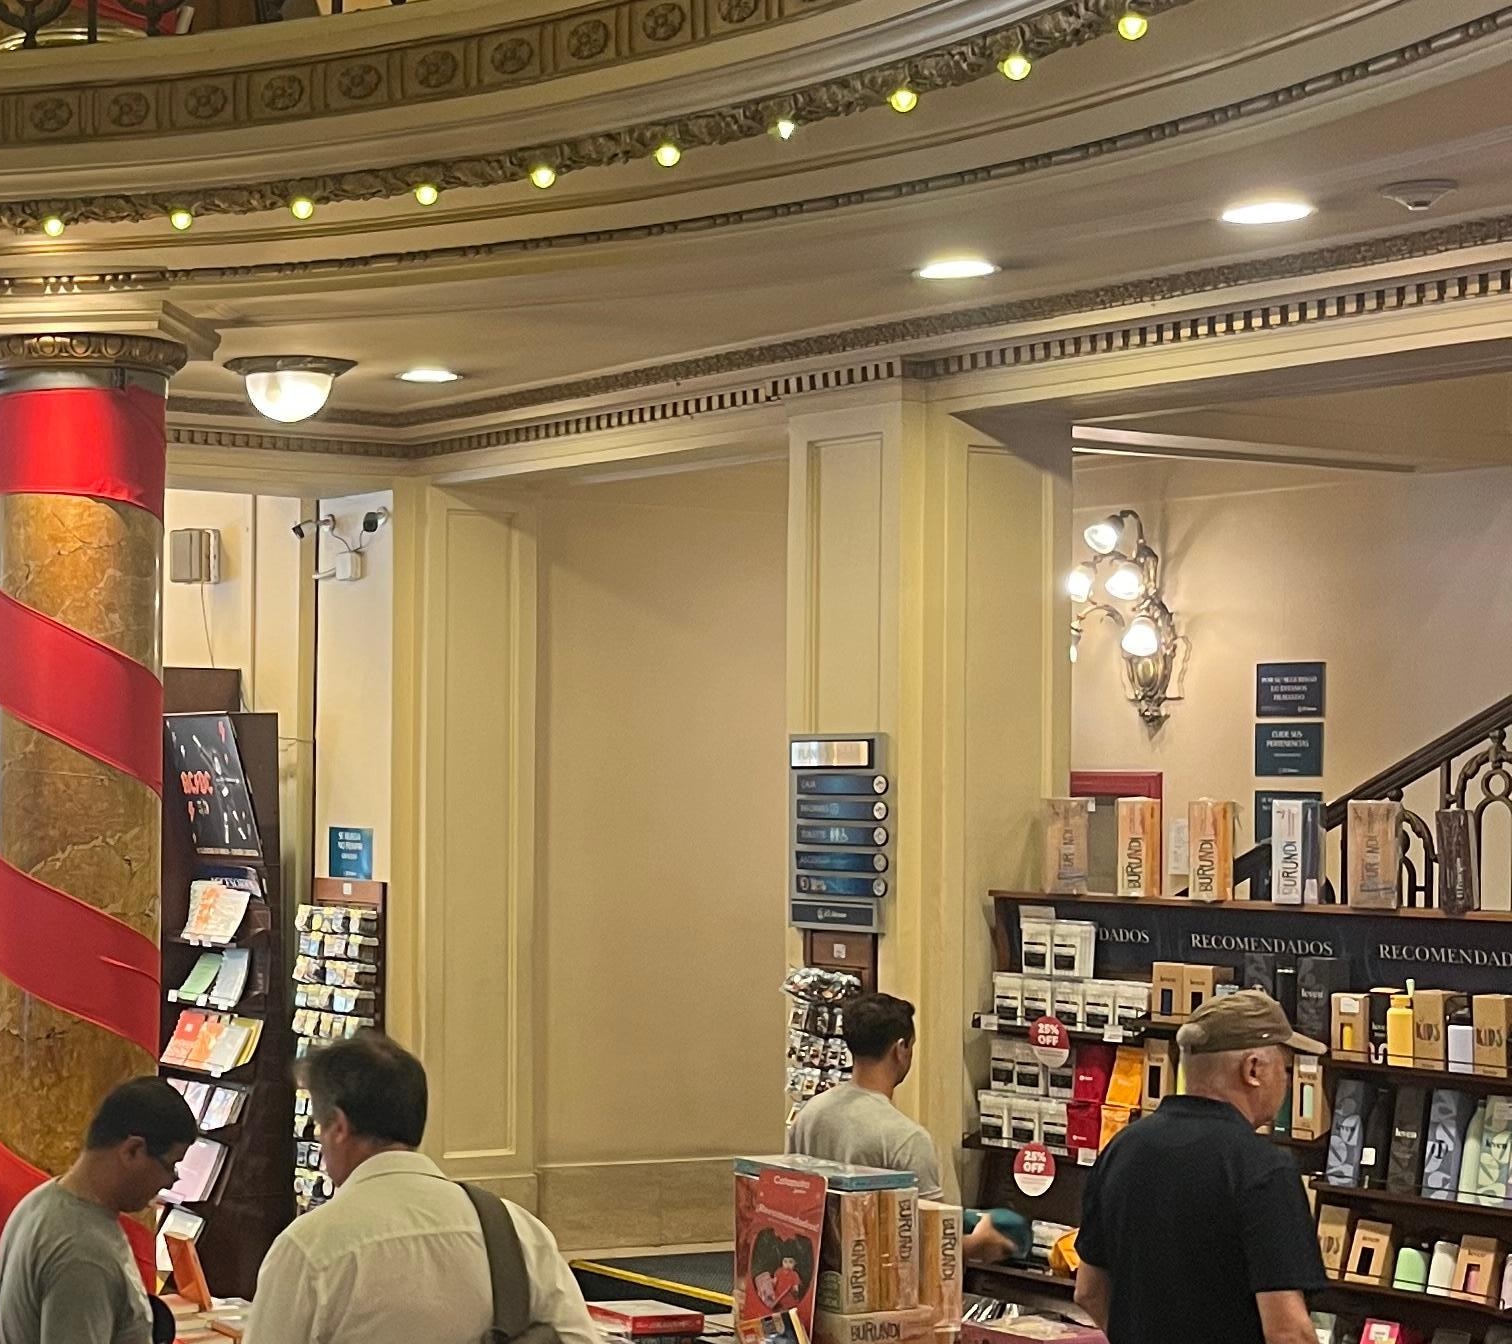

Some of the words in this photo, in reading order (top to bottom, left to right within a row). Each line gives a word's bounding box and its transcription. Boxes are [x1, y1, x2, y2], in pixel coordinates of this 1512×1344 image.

[1127, 836, 1144, 893] BURUNDI
[1199, 838, 1216, 892] BURUNDI
[1281, 840, 1299, 895] BURUNDI
[1191, 932, 1334, 956] RECOMENDADOS
[1038, 1022, 1059, 1036] 25%
[1038, 1035, 1059, 1047] OFF
[1476, 1026, 1503, 1047] KIDS
[1023, 1161, 1045, 1174] OFF
[1024, 1151, 1047, 1163] 25%
[898, 1199, 913, 1264] BURUNDI
[941, 1217, 956, 1282] BURUNDI
[850, 1238, 867, 1304] BURUNDI
[850, 1321, 901, 1342] BURUNDI
